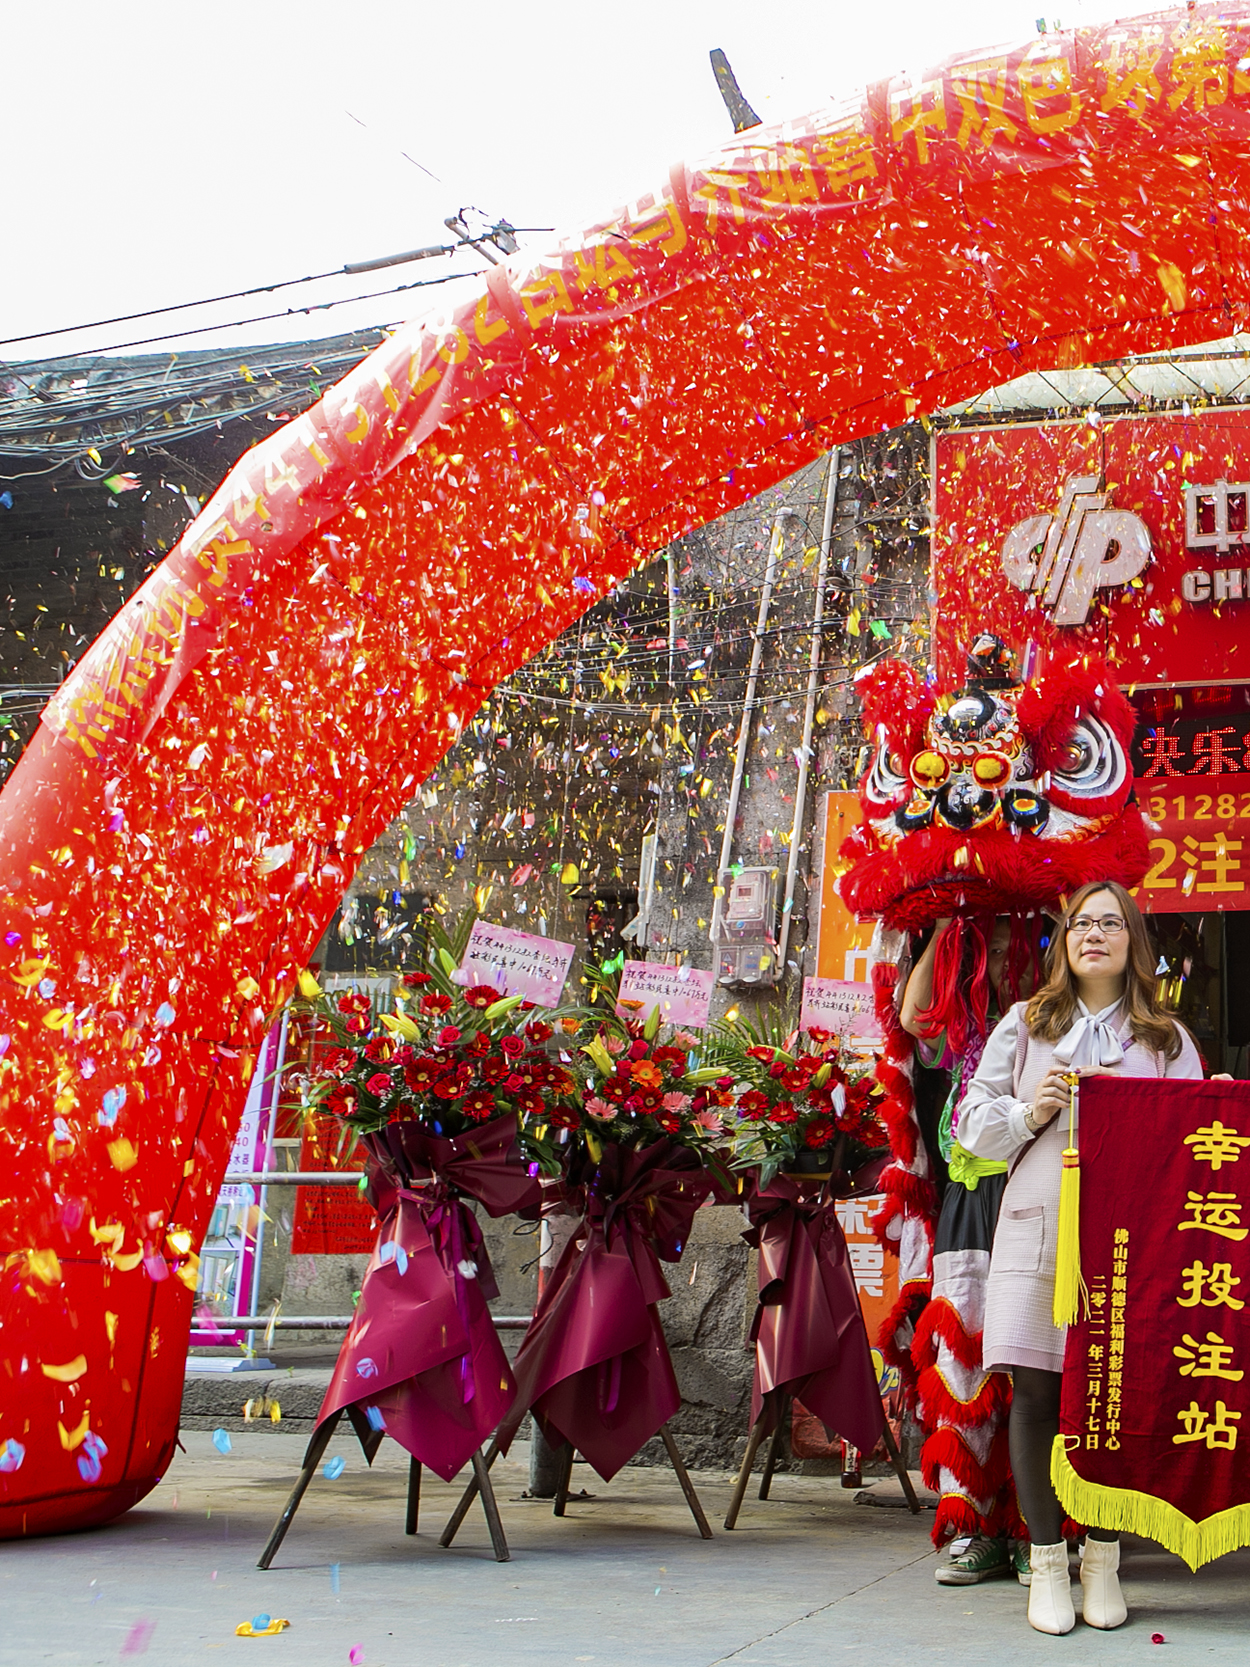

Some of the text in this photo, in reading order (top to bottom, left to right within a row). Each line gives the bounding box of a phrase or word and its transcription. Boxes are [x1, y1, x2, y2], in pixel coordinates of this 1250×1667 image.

[1085, 1275, 1107, 1451] 二零二一年三月十七日
[1104, 1227, 1130, 1451] 佛山市顺德区福利彩票发行中心
